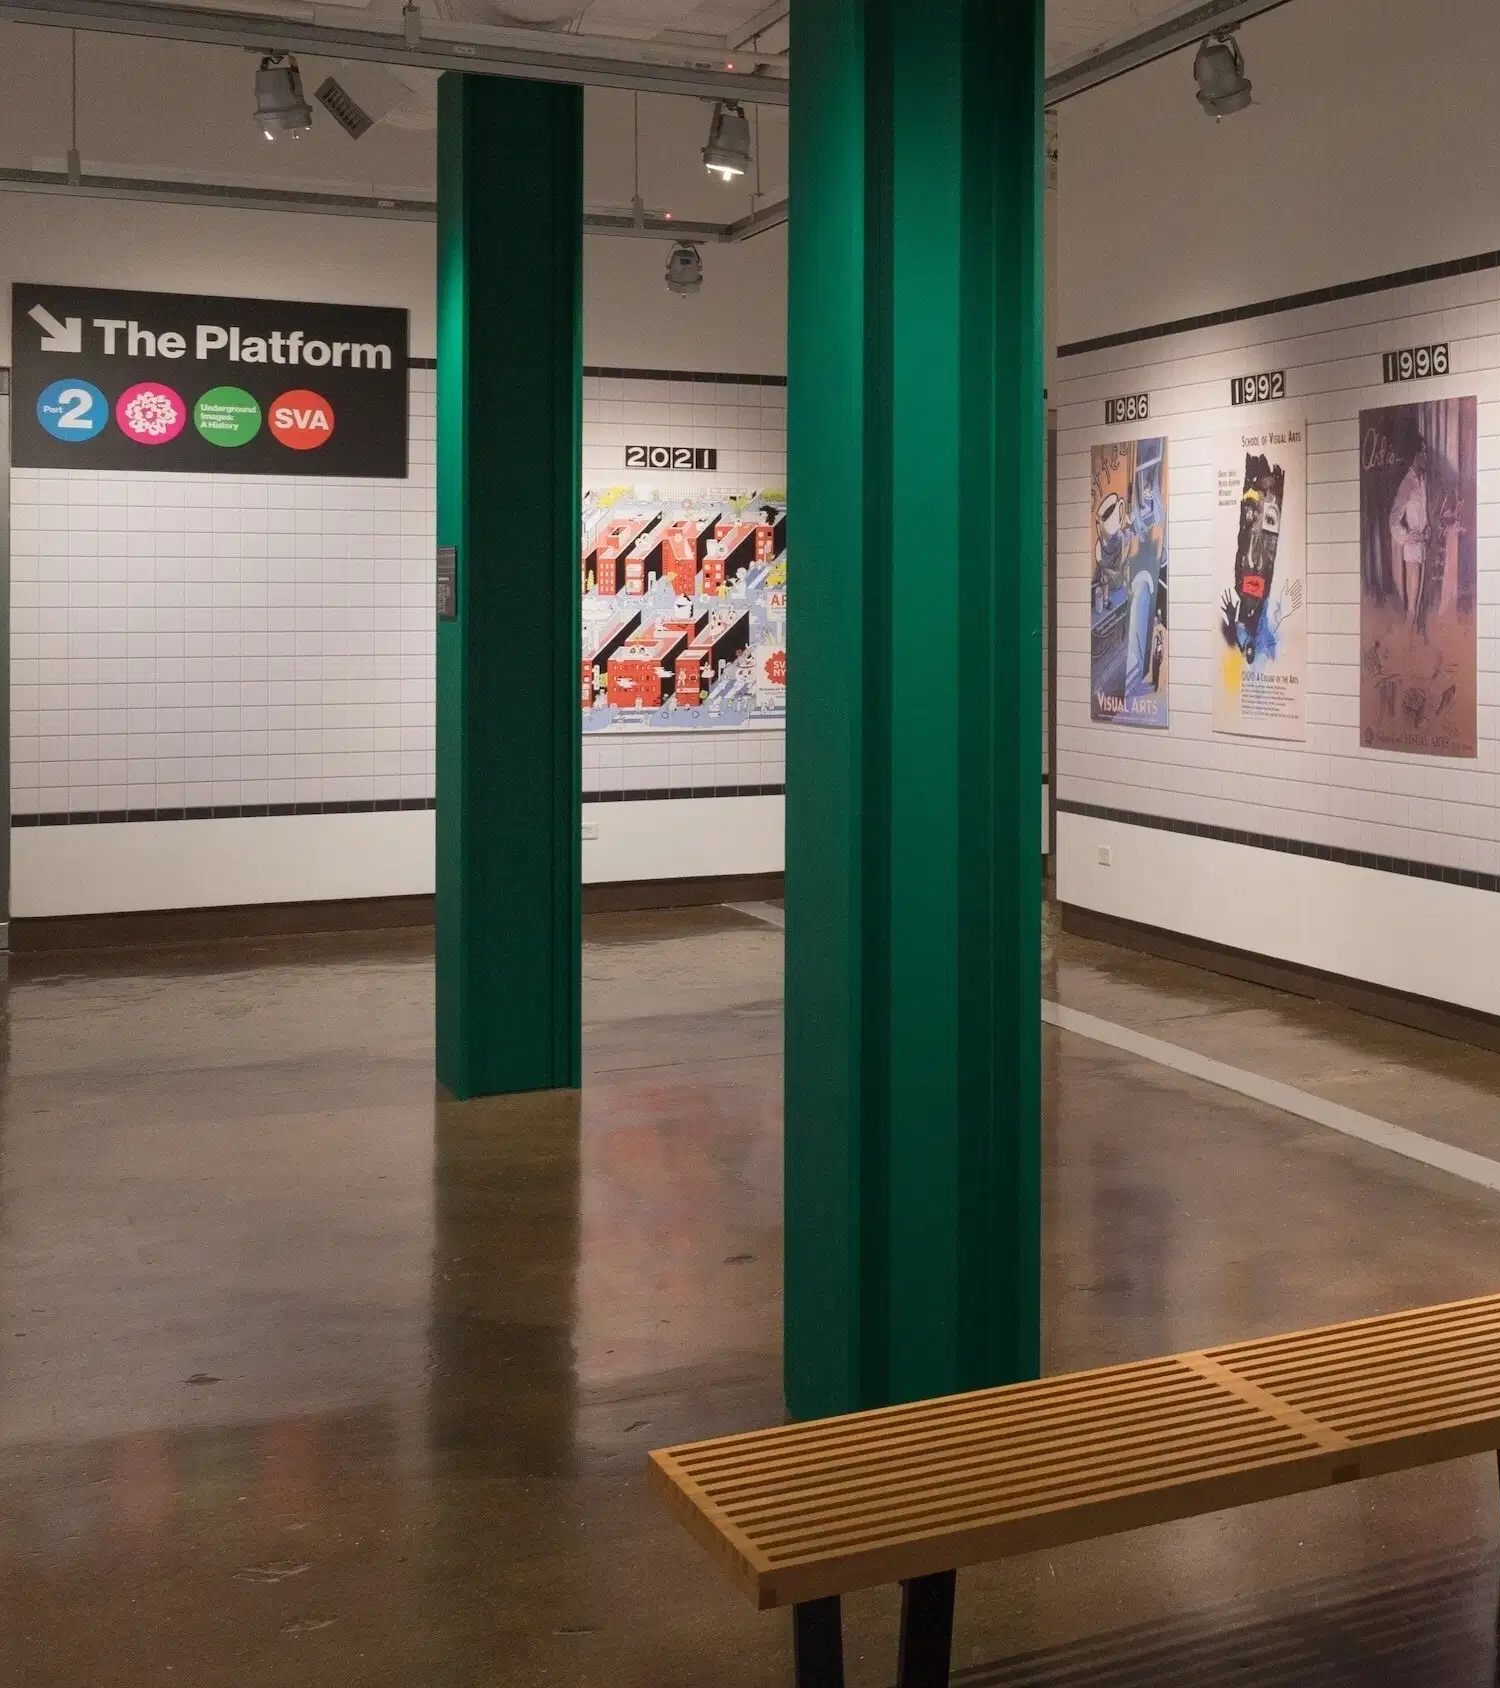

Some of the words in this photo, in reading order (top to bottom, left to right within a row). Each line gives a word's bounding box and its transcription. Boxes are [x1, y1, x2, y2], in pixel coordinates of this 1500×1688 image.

[93, 318, 187, 359] The
[195, 324, 393, 370] Platform
[1388, 345, 1448, 381] 1996
[1235, 372, 1284, 403] 1992
[43, 405, 63, 414] Part
[57, 388, 93, 429] 2
[200, 403, 257, 415] Underground
[200, 413, 234, 422] Images:
[274, 408, 329, 431] SVA
[1109, 395, 1148, 422] 1986
[200, 421, 208, 429] A
[209, 421, 239, 431] History
[1241, 436, 1260, 447] SCHOOL
[1261, 436, 1267, 445] OF
[1268, 432, 1287, 444] VISUAL
[1288, 430, 1302, 442] ARTS
[626, 446, 710, 469] 2021
[773, 660, 786, 669] SV
[773, 669, 786, 677] NY
[1097, 691, 1129, 712] VISUAL
[1131, 696, 1158, 715] ARTS
